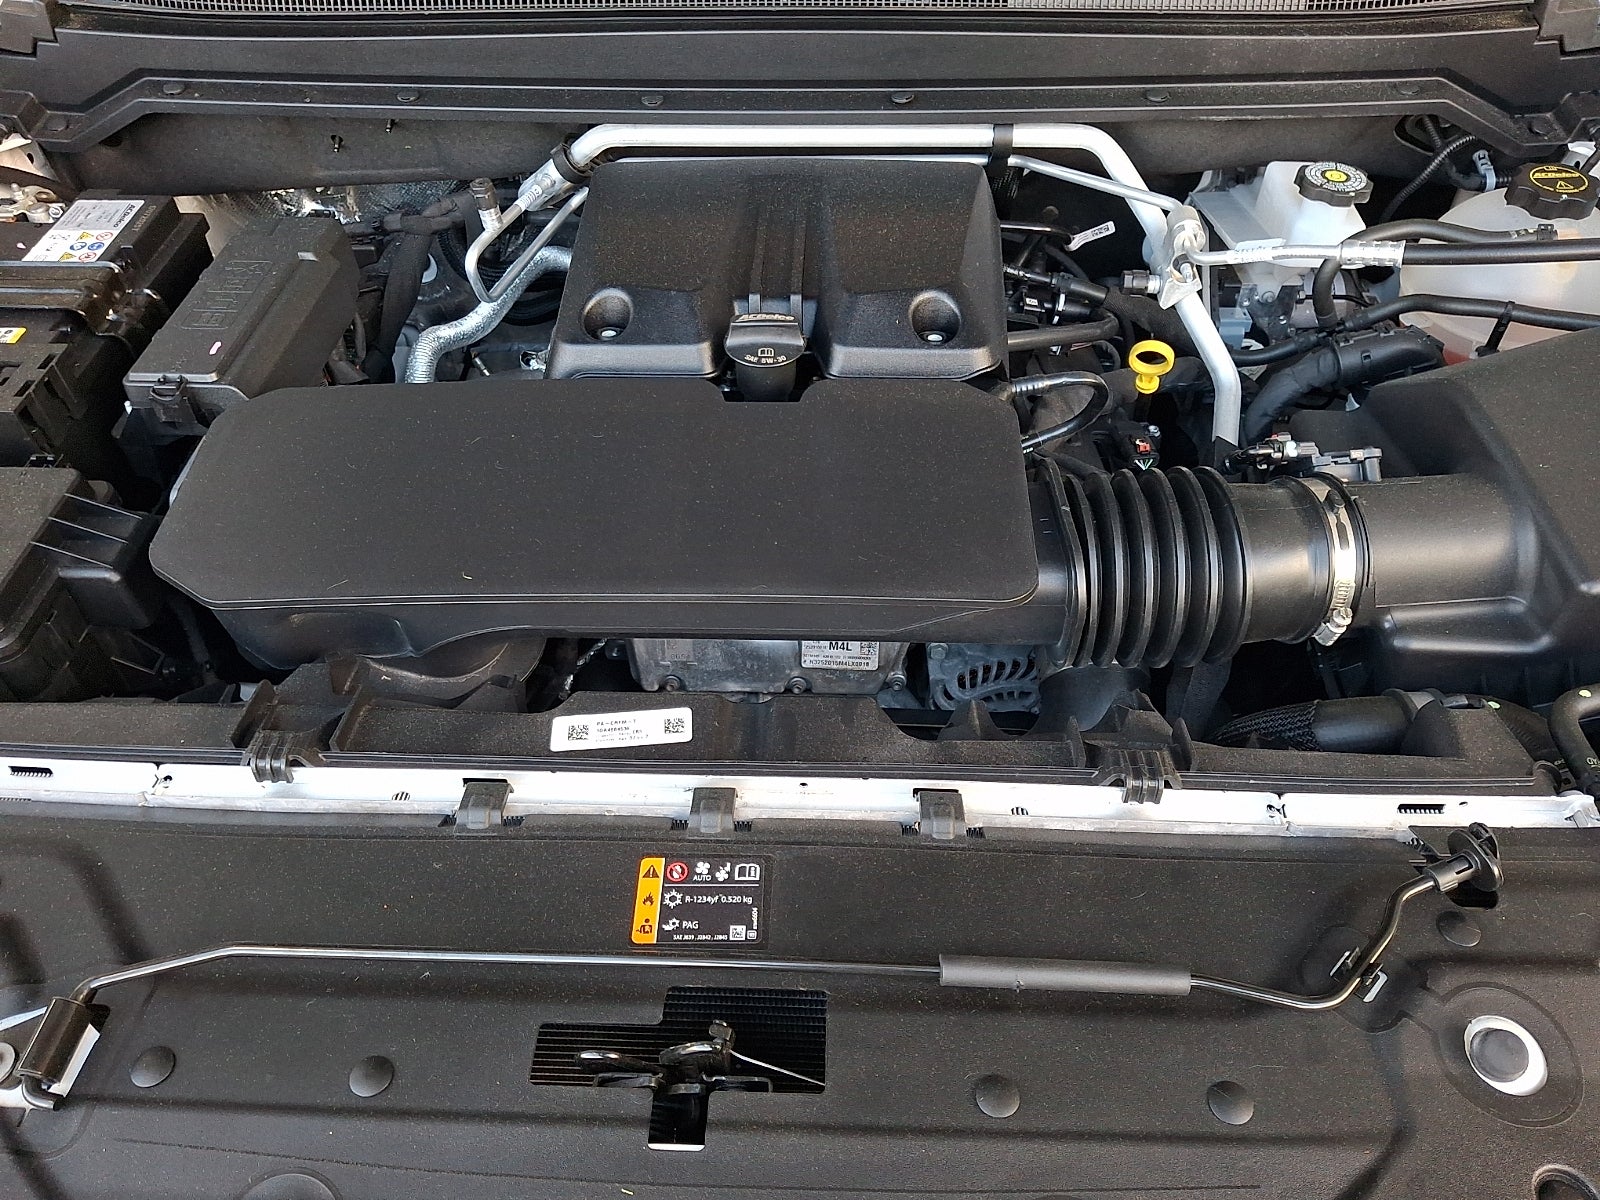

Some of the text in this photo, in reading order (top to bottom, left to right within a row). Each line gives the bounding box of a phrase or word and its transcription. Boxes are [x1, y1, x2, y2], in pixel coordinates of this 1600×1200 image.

[113, 204, 136, 228] ACDelco
[736, 314, 794, 322] ACDelco
[744, 354, 787, 364] SAE 5W-30
[829, 642, 852, 651] M4L
[685, 895, 752, 904] R-1234yf 0.520 kg
[682, 920, 699, 929] PAG
